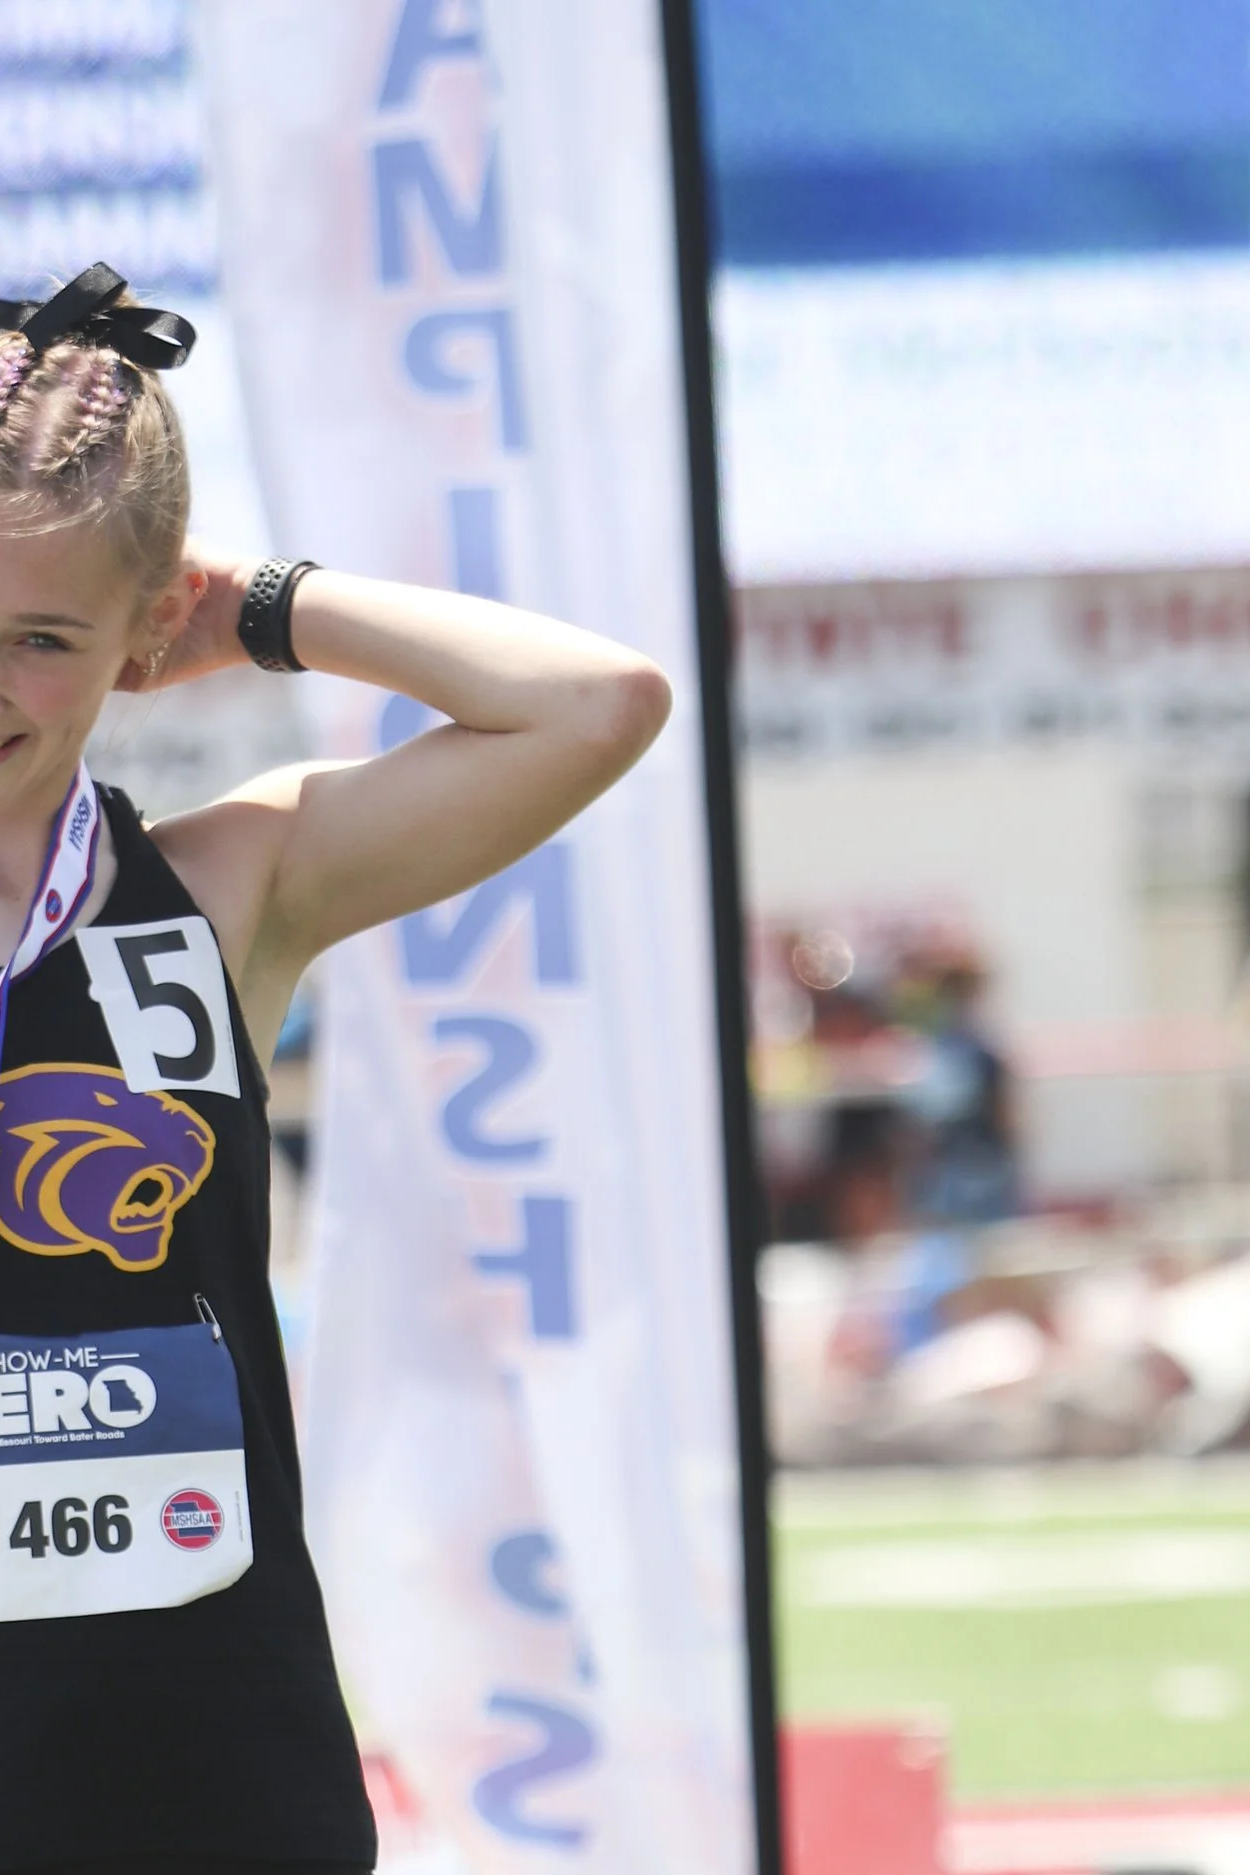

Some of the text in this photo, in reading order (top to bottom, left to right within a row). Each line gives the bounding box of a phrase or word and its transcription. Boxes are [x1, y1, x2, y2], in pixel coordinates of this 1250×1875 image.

[114, 929, 216, 1082] 5
[33, 1433, 68, 1444] Toward
[96, 1430, 125, 1441] Roads
[172, 1511, 213, 1527] MSHSAA
